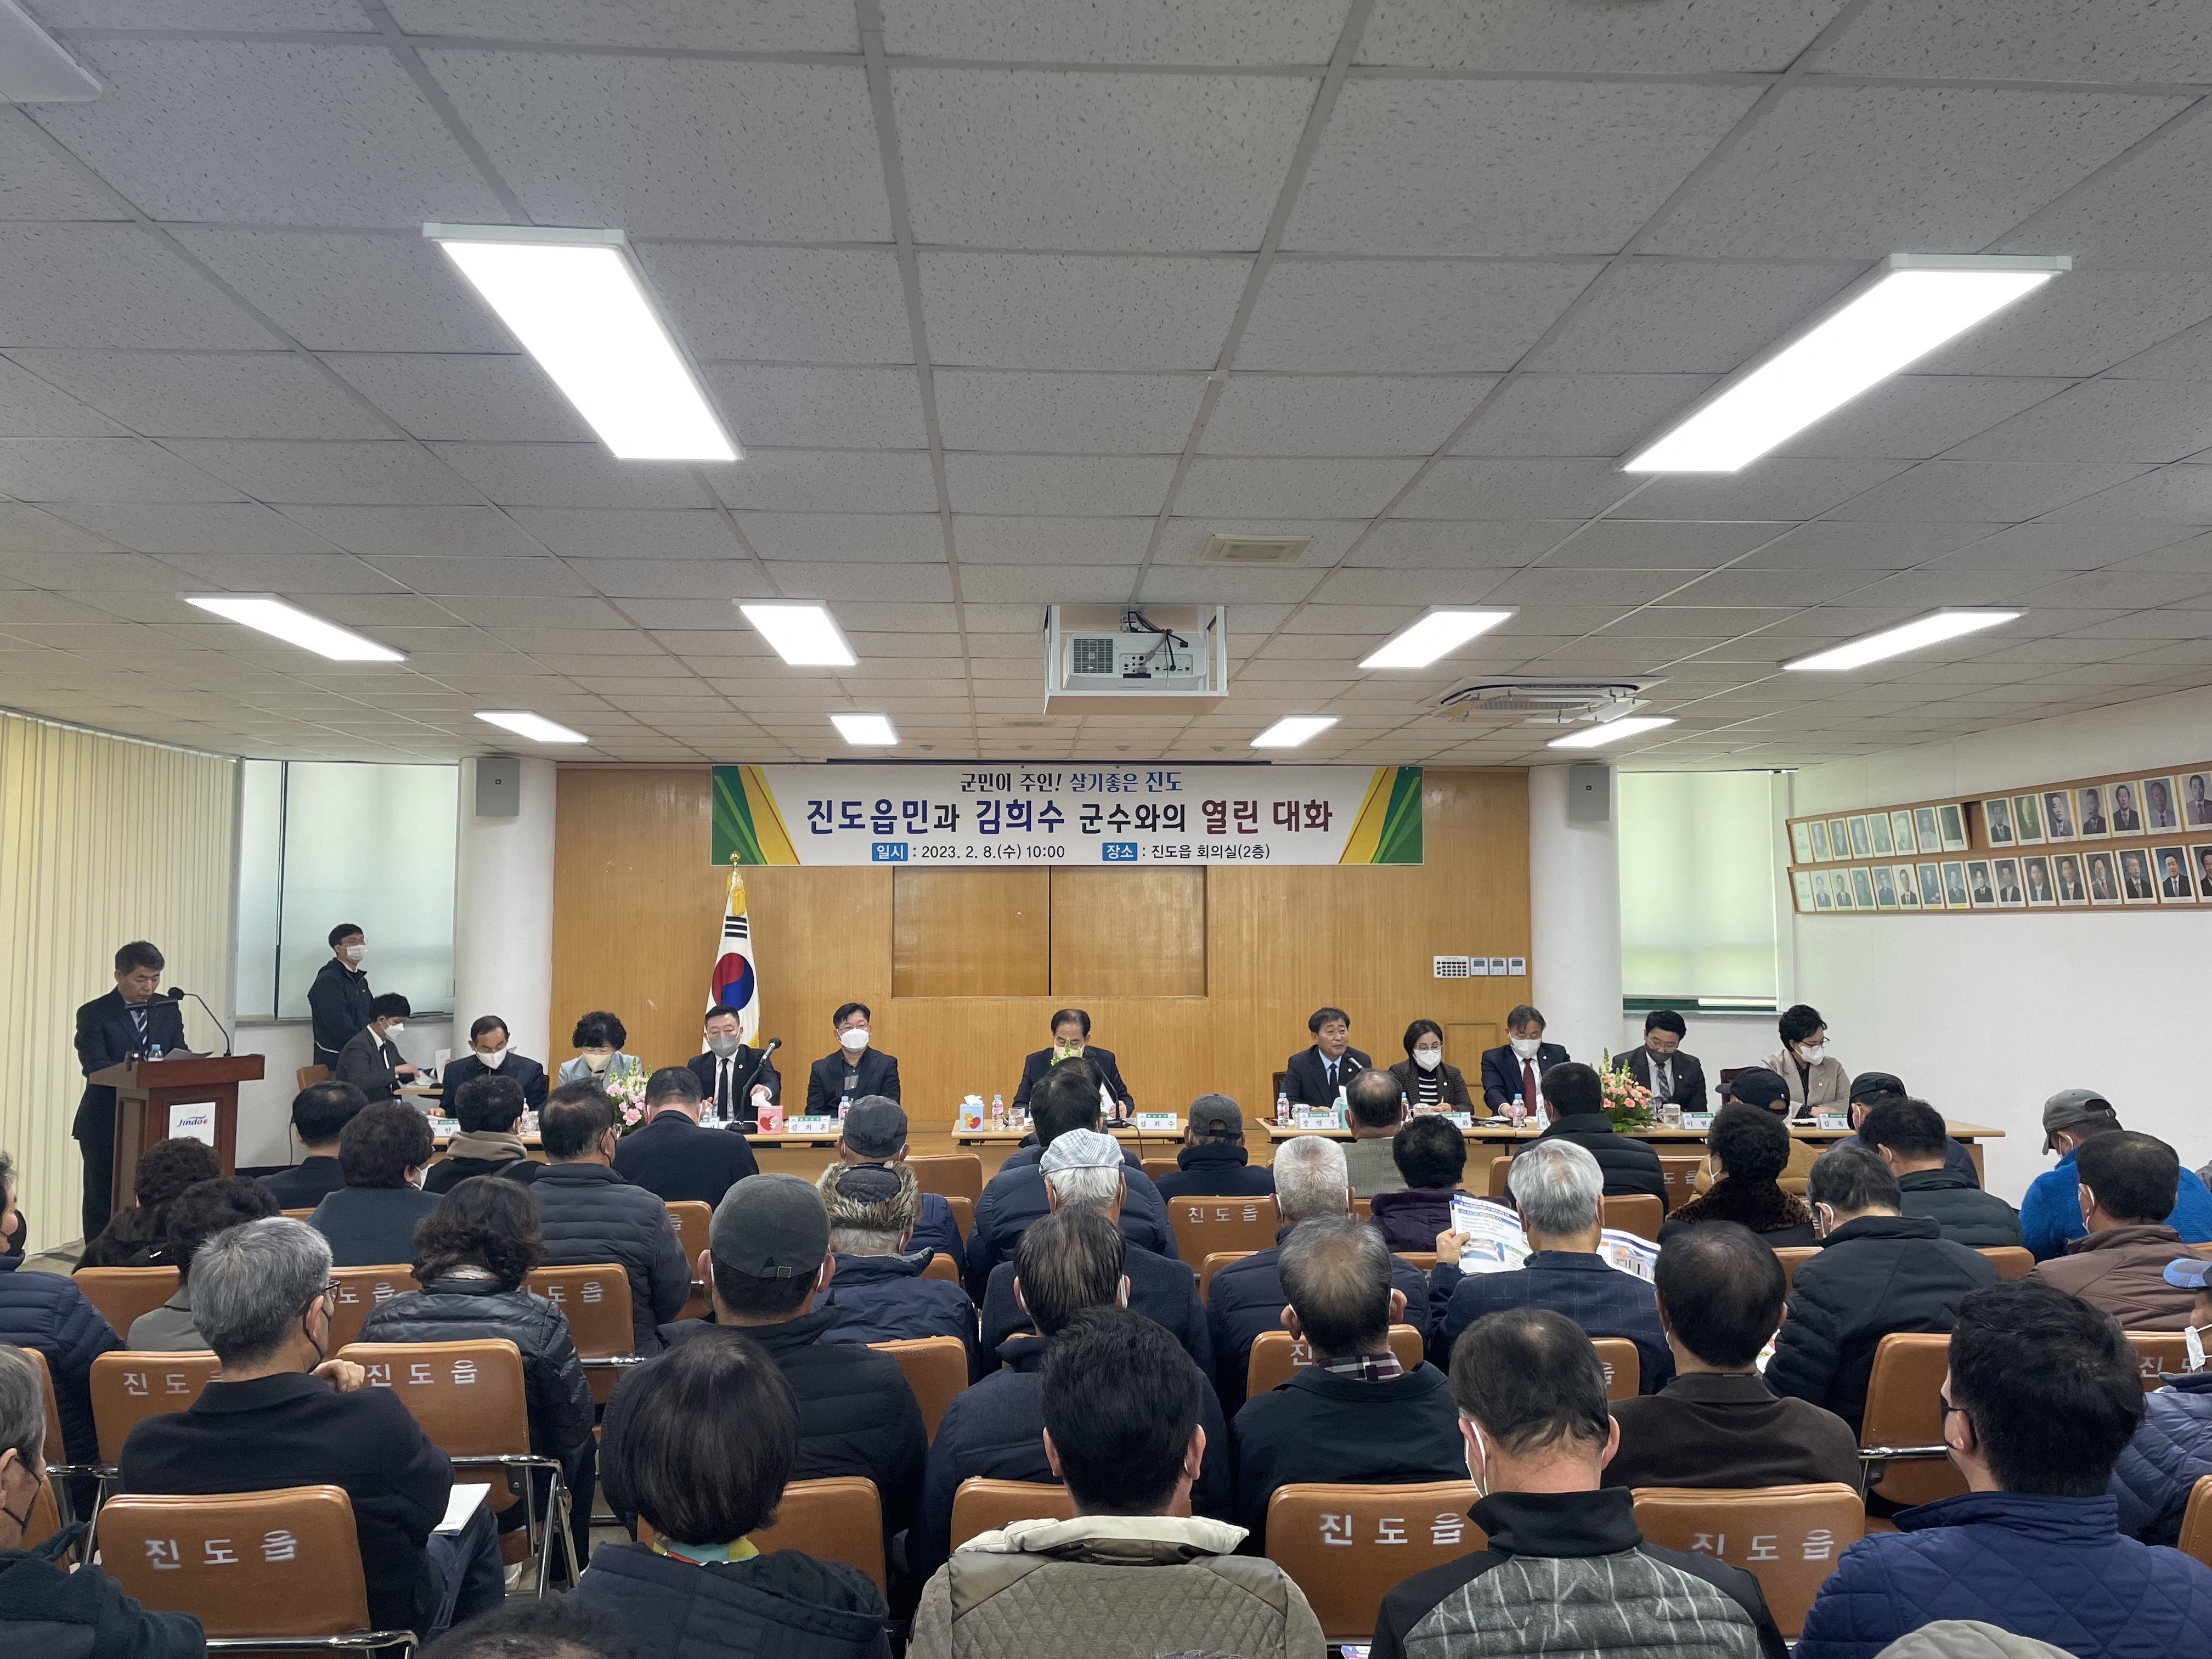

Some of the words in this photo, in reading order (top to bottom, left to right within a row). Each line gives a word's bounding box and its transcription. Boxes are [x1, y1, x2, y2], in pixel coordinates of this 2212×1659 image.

[960, 772, 1011, 792] 군민이
[1020, 772, 1062, 792] 주인!
[1070, 773, 1138, 793] 살기좋은
[1145, 771, 1183, 792] 진도
[806, 799, 960, 835] 진도읍민과
[975, 798, 1065, 834] 김희수
[1079, 803, 1186, 835] 군수와의
[1201, 799, 1259, 834] 열린
[1273, 799, 1333, 832] 대화
[876, 845, 905, 860] 일시
[922, 845, 960, 859] 2023.
[966, 845, 978, 859] 2.
[983, 844, 1022, 860] 8.(수)
[1026, 845, 1065, 858] 10:00
[1107, 844, 1134, 859] 장소
[1151, 844, 1192, 859] 진도읍
[1197, 844, 1271, 860] 회의실(2층)
[367, 1359, 478, 1387] 진도읍
[1319, 1513, 1465, 1546] 진도읍
[144, 1529, 297, 1571] 진도읍
